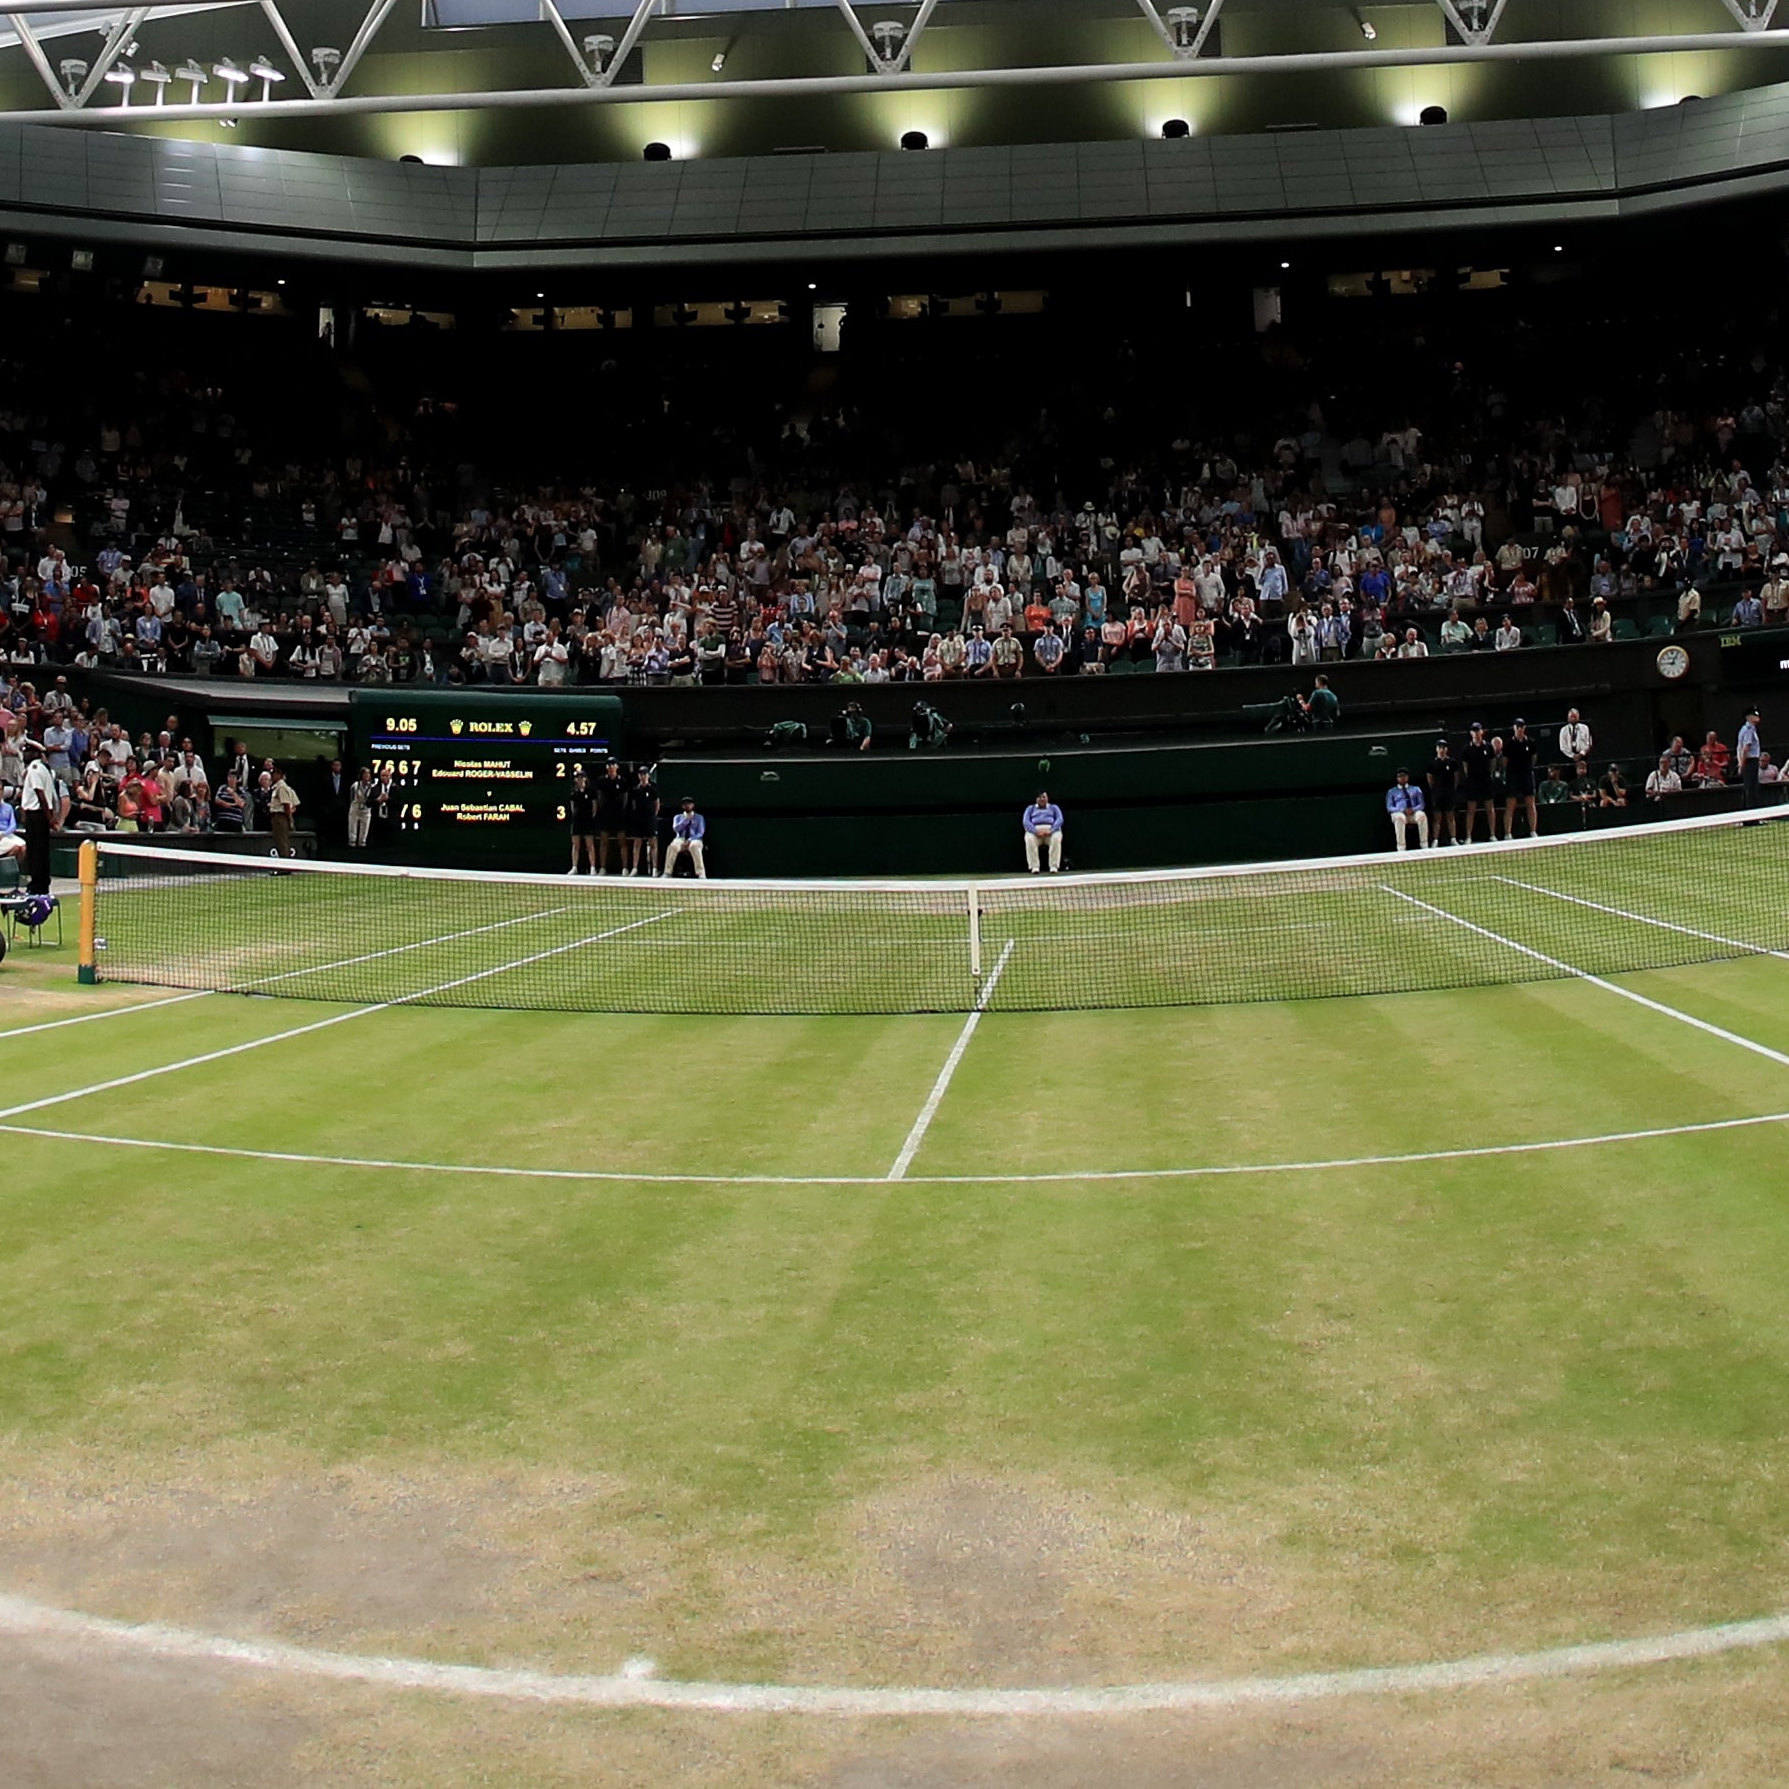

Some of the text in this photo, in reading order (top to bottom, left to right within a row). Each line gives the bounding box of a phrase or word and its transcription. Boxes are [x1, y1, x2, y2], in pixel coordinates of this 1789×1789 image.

[1721, 635, 1742, 648] IBM
[386, 718, 418, 732] 9.05
[469, 721, 514, 734] ROLEX
[566, 721, 597, 736] 4.57
[372, 759, 382, 774] 7
[398, 760, 409, 775] 6
[411, 760, 422, 776] 7
[454, 759, 511, 769] Nicolas MAHUT
[555, 762, 566, 778] 2
[412, 803, 422, 819] 6
[440, 803, 460, 812] Juan
[498, 804, 526, 813] CABAL
[556, 805, 567, 821] 3
[456, 812, 510, 821] Robert FARAH
